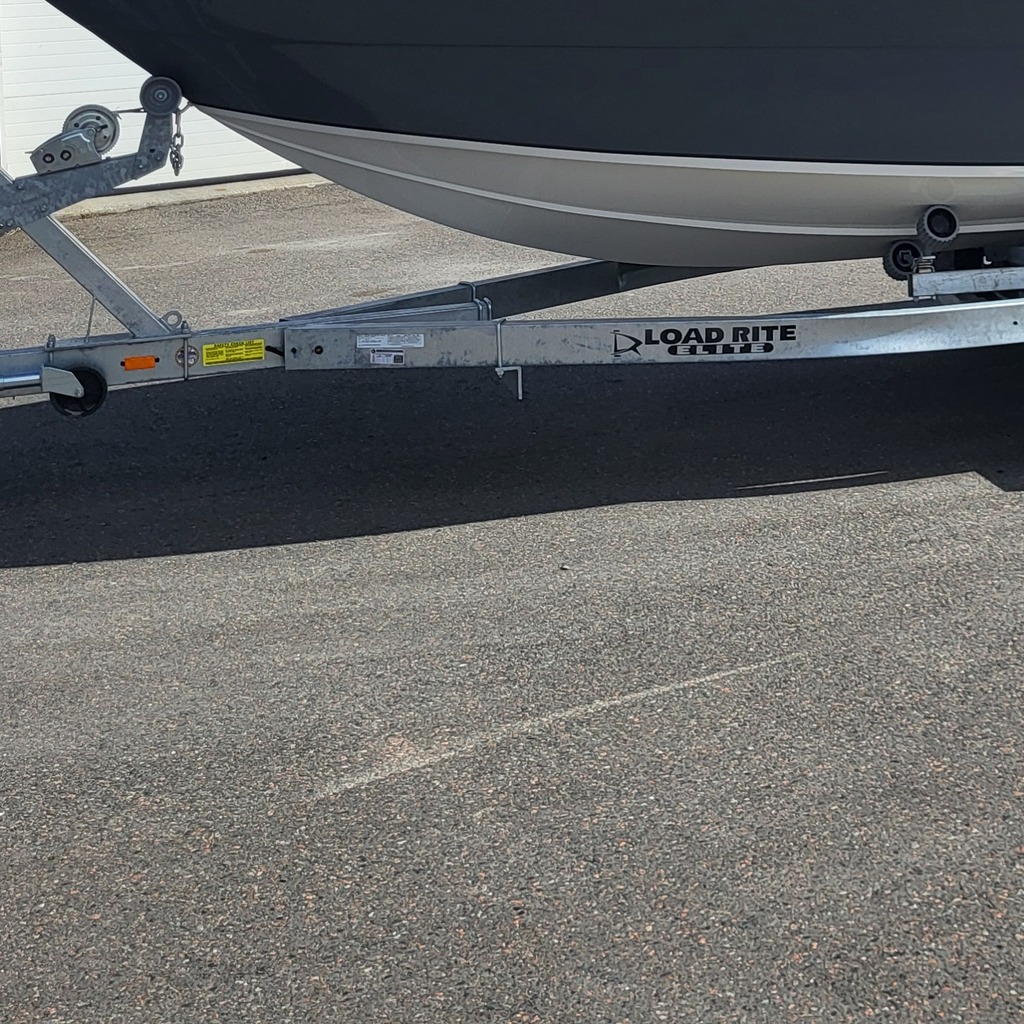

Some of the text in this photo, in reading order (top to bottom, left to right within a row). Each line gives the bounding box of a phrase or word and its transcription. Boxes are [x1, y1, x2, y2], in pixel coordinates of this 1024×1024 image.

[644, 325, 797, 345] LOAD RITE
[676, 343, 766, 355] ELITE
